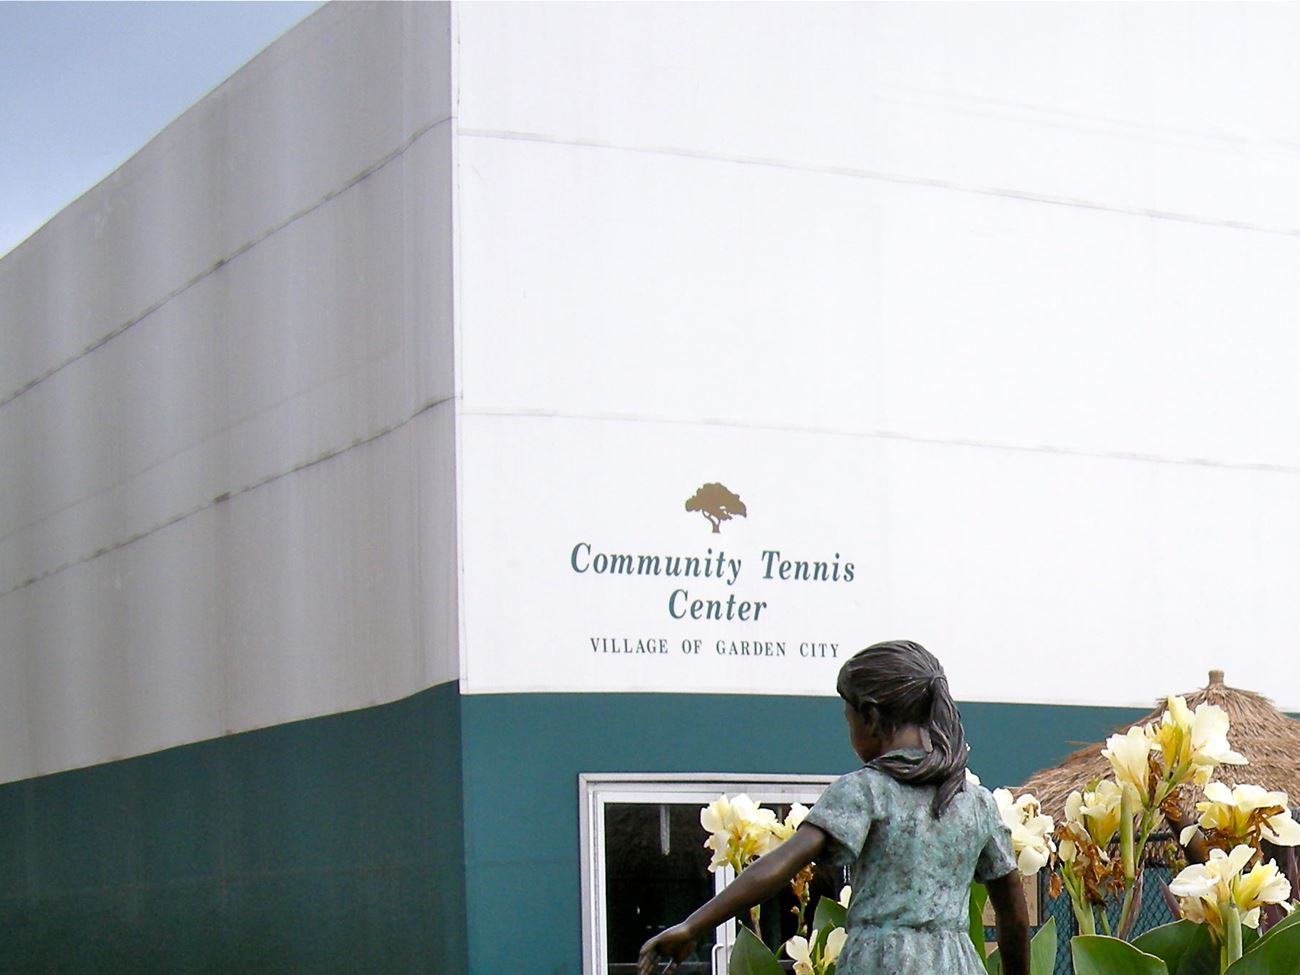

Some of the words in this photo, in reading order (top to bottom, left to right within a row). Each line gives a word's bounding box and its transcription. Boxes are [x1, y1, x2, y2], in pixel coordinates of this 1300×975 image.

[570, 542, 742, 586] Community
[761, 550, 856, 583] Tennis
[668, 588, 768, 621] Center
[590, 637, 669, 654] VILLAGE
[681, 639, 703, 654] OF
[715, 640, 787, 657] GARDEN
[799, 642, 839, 658] CITY
